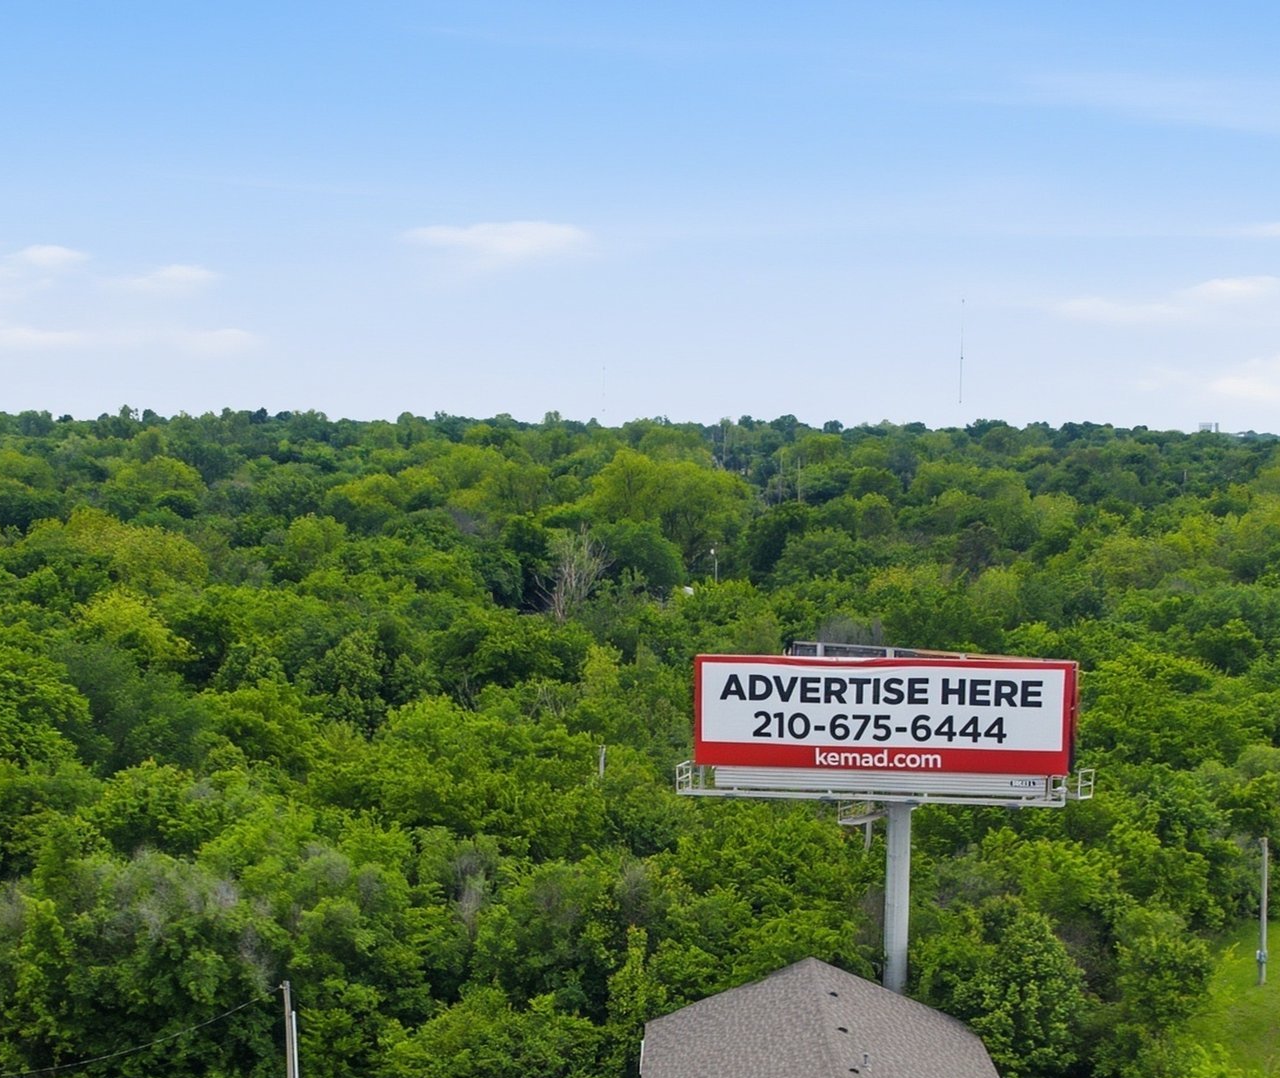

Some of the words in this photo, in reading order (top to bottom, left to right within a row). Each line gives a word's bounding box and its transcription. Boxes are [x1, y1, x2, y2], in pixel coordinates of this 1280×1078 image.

[720, 674, 928, 705] ADVERTISE
[941, 678, 1043, 708] HERE
[752, 711, 1007, 744] 210-675-6444
[815, 747, 942, 769] kemad.com
